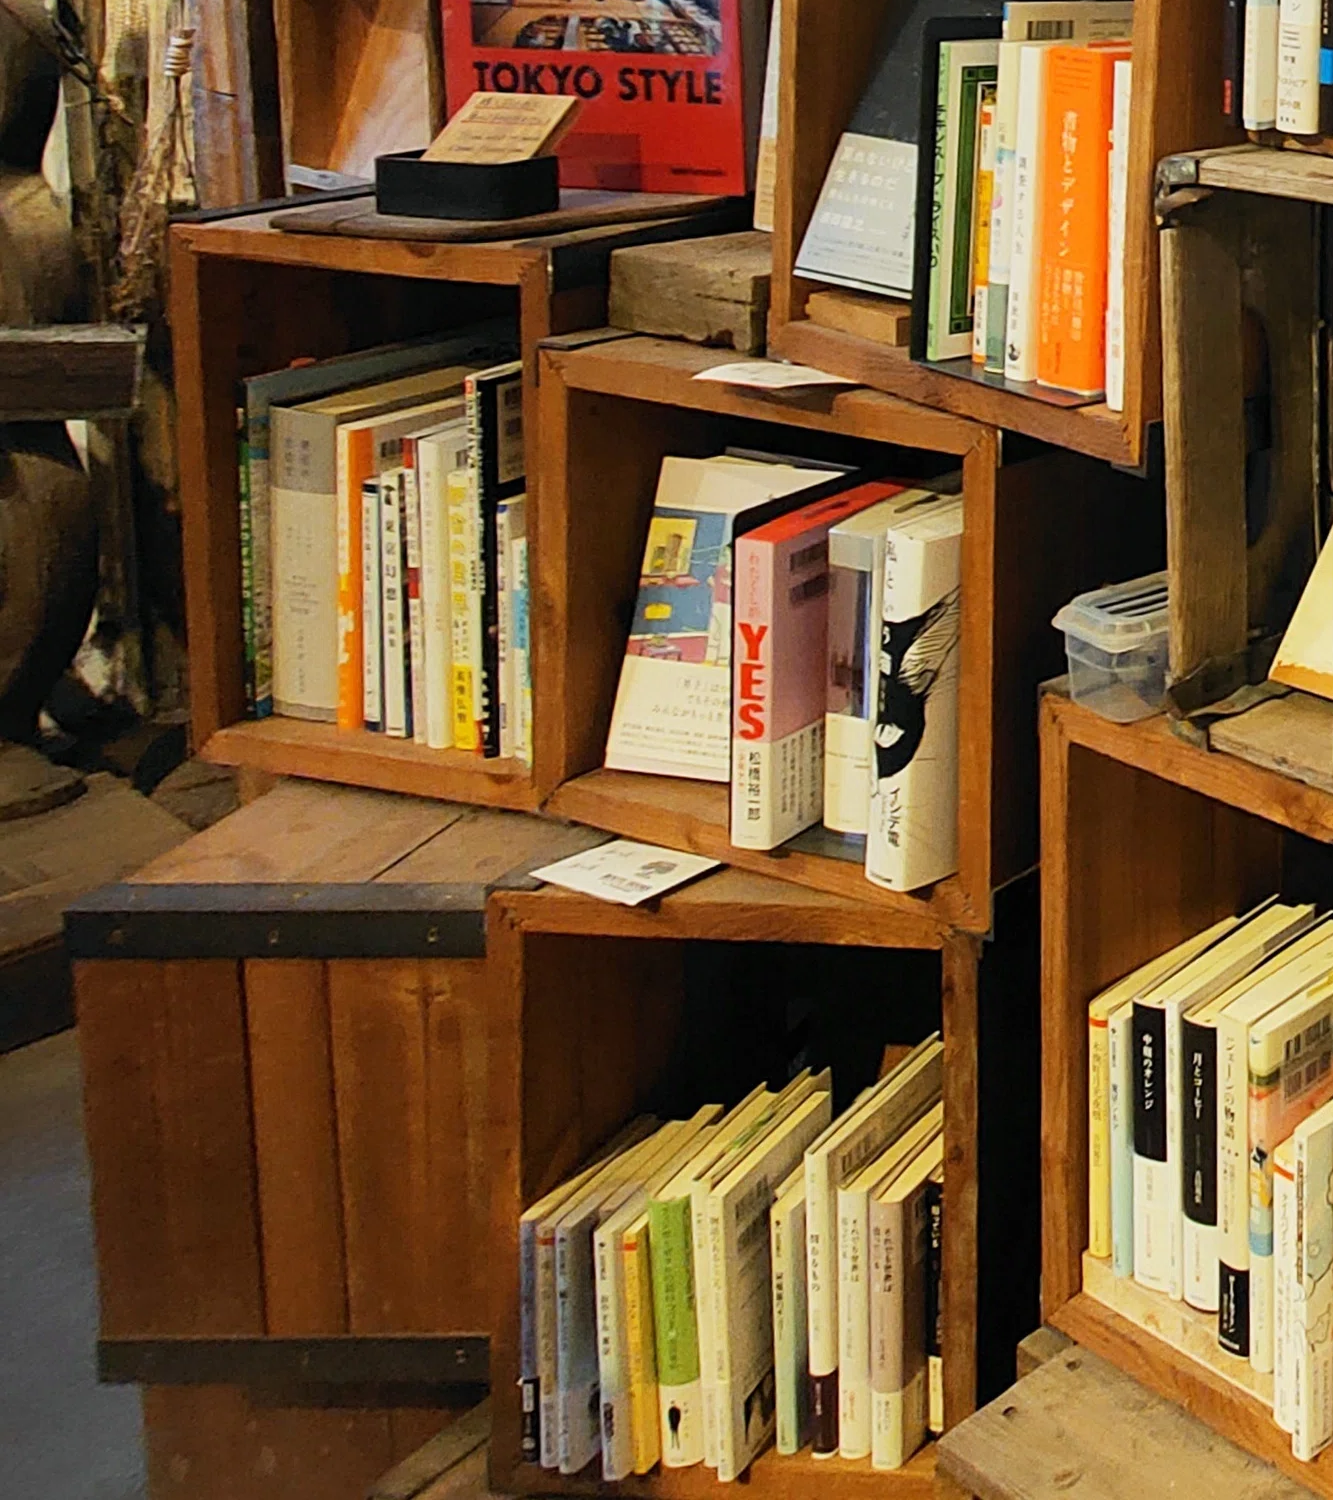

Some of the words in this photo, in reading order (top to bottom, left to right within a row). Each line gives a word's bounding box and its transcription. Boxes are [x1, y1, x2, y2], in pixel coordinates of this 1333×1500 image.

[472, 60, 604, 100] TOKYO
[618, 67, 723, 106] STYLE
[736, 622, 768, 742] YES
[1192, 1052, 1204, 1120] 月とコーヒー
